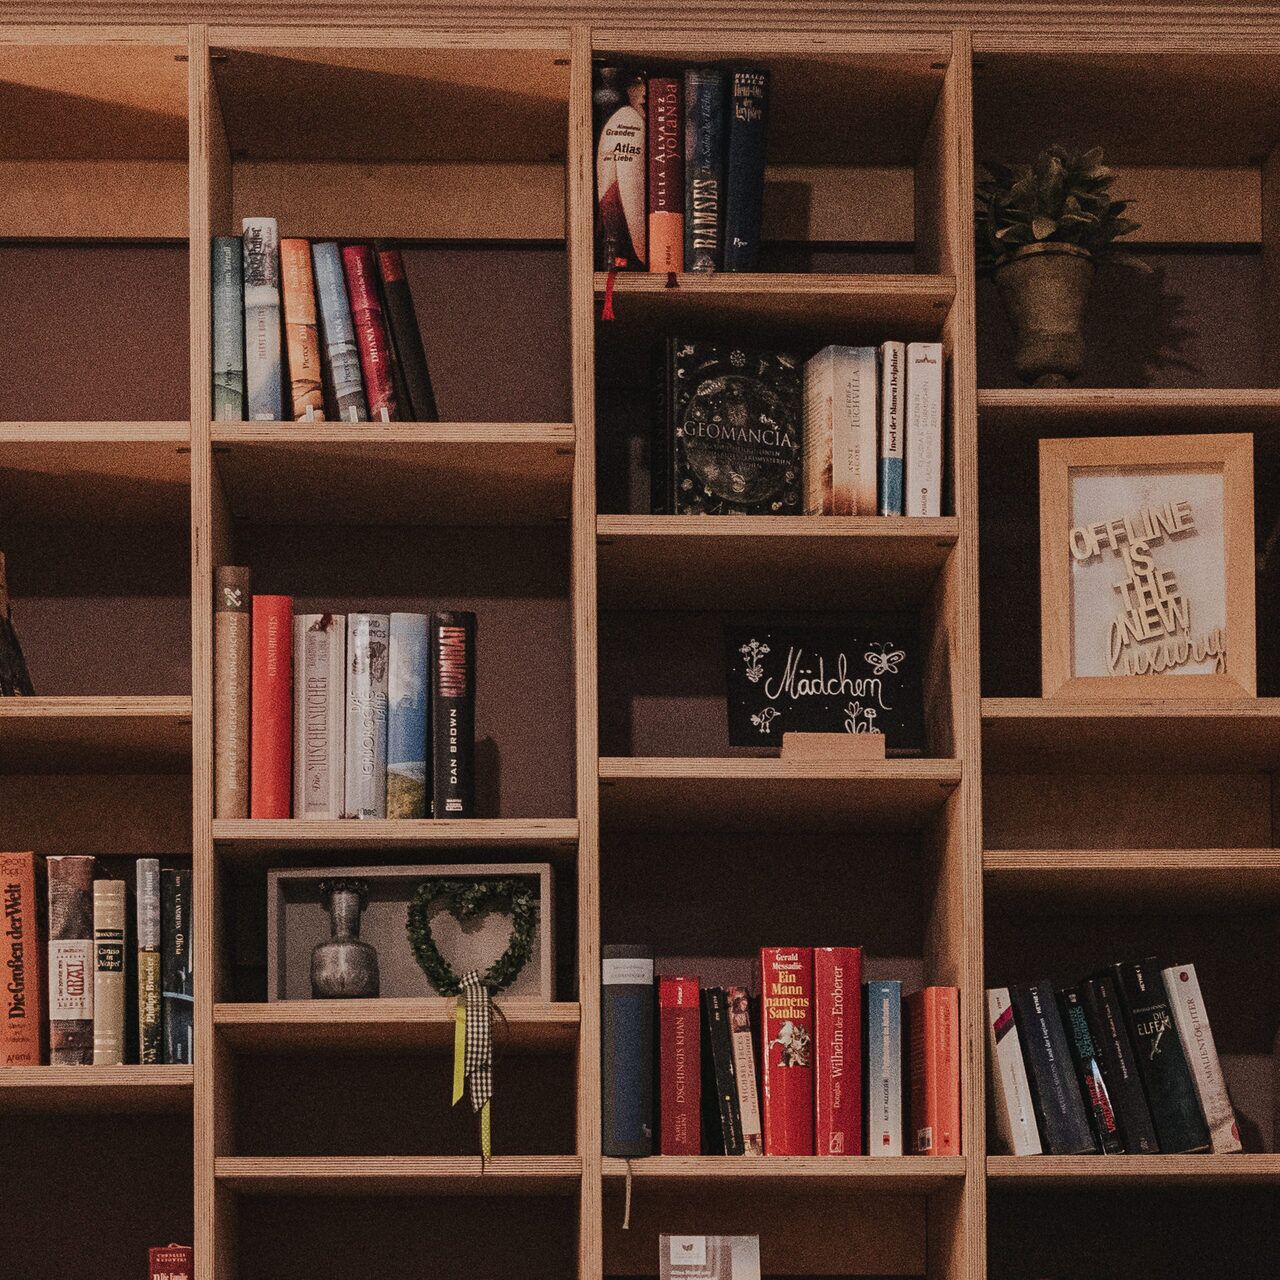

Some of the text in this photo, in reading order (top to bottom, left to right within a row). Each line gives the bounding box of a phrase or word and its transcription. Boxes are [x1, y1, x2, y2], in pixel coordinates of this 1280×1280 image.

[606, 128, 636, 138] Grandes
[613, 142, 642, 156] Atlas
[654, 96, 669, 215] JULIA ALVAREZ
[613, 154, 633, 162] Liebe
[693, 180, 718, 248] RAMSES
[366, 327, 380, 362] DHANA
[890, 348, 899, 452] Insel der blauen Delphine
[1069, 500, 1195, 560] OFFLINE
[1125, 540, 1154, 578] IS
[1114, 570, 1178, 613] THE
[1117, 597, 1191, 645] NEW
[438, 626, 466, 698] ILLUMINATI
[1106, 625, 1227, 678] luxury
[764, 646, 894, 712] Mädchen
[308, 676, 327, 772] MUSCHELSUCHER
[450, 708, 458, 784] DAN BROWN
[775, 953, 798, 962] Gerald
[778, 971, 798, 984] Ein
[9, 998, 26, 1020] Die
[144, 957, 158, 1022] Philipp Brucker
[765, 996, 810, 1008] namens
[771, 984, 804, 996] Mann
[768, 1006, 806, 1020] Saulus
[1137, 1017, 1171, 1036] ELFEN
[830, 966, 844, 1108] Douglas Wilhelm der Eroberer
[1186, 998, 1215, 1084] AMALIENTÖCHTER
[676, 1016, 685, 1104] DSCHINGIS KHAN
[160, 1272, 188, 1280] Die Familie
